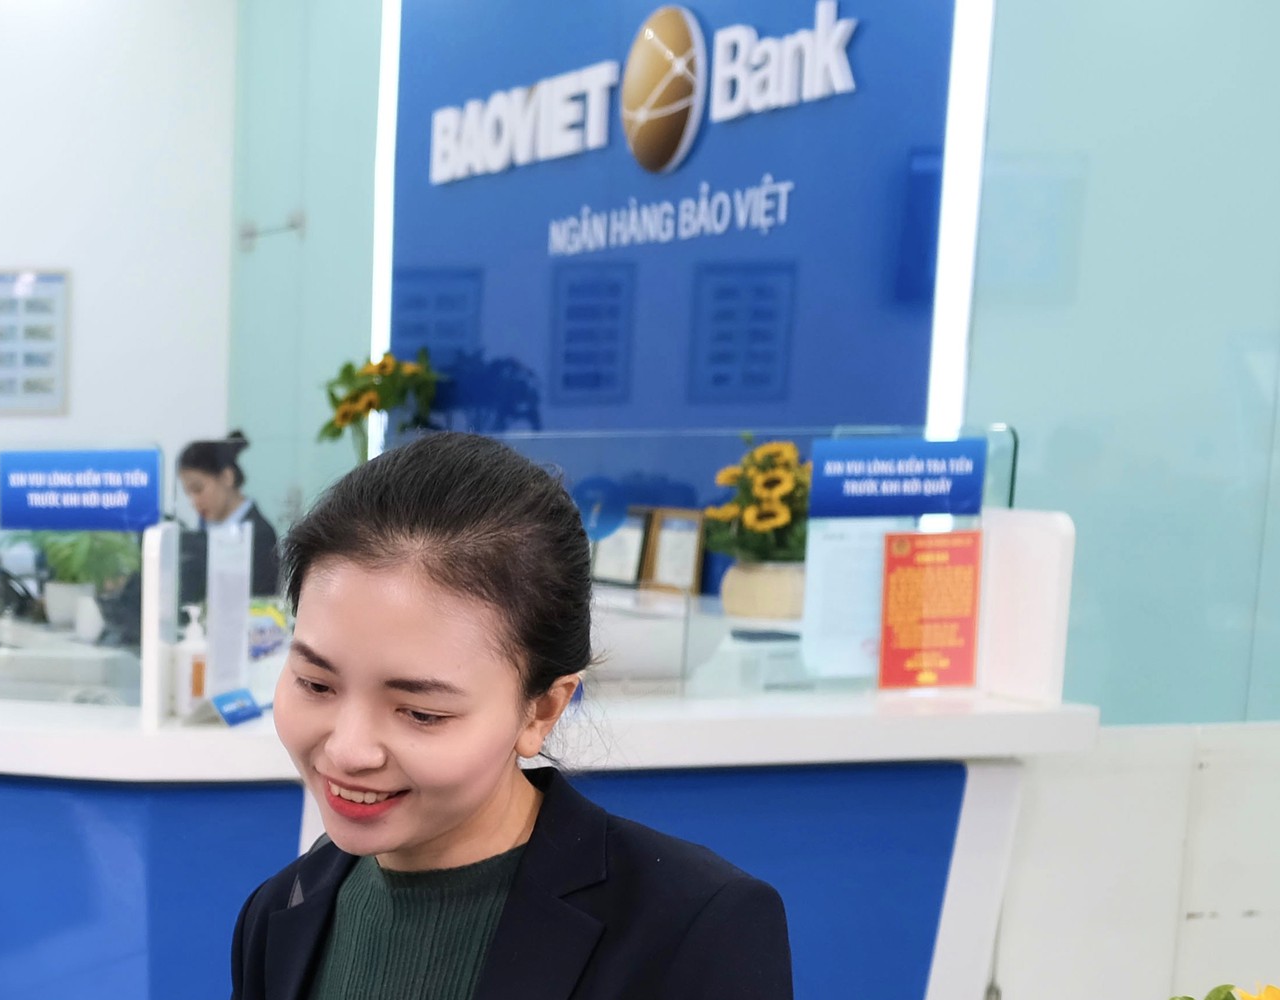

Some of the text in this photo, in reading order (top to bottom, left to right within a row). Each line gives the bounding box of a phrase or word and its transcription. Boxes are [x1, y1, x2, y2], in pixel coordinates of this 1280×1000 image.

[430, 0, 858, 185] BAOVIET Bank
[549, 173, 794, 257] NGÂN HÀNG BẢO VIỆT
